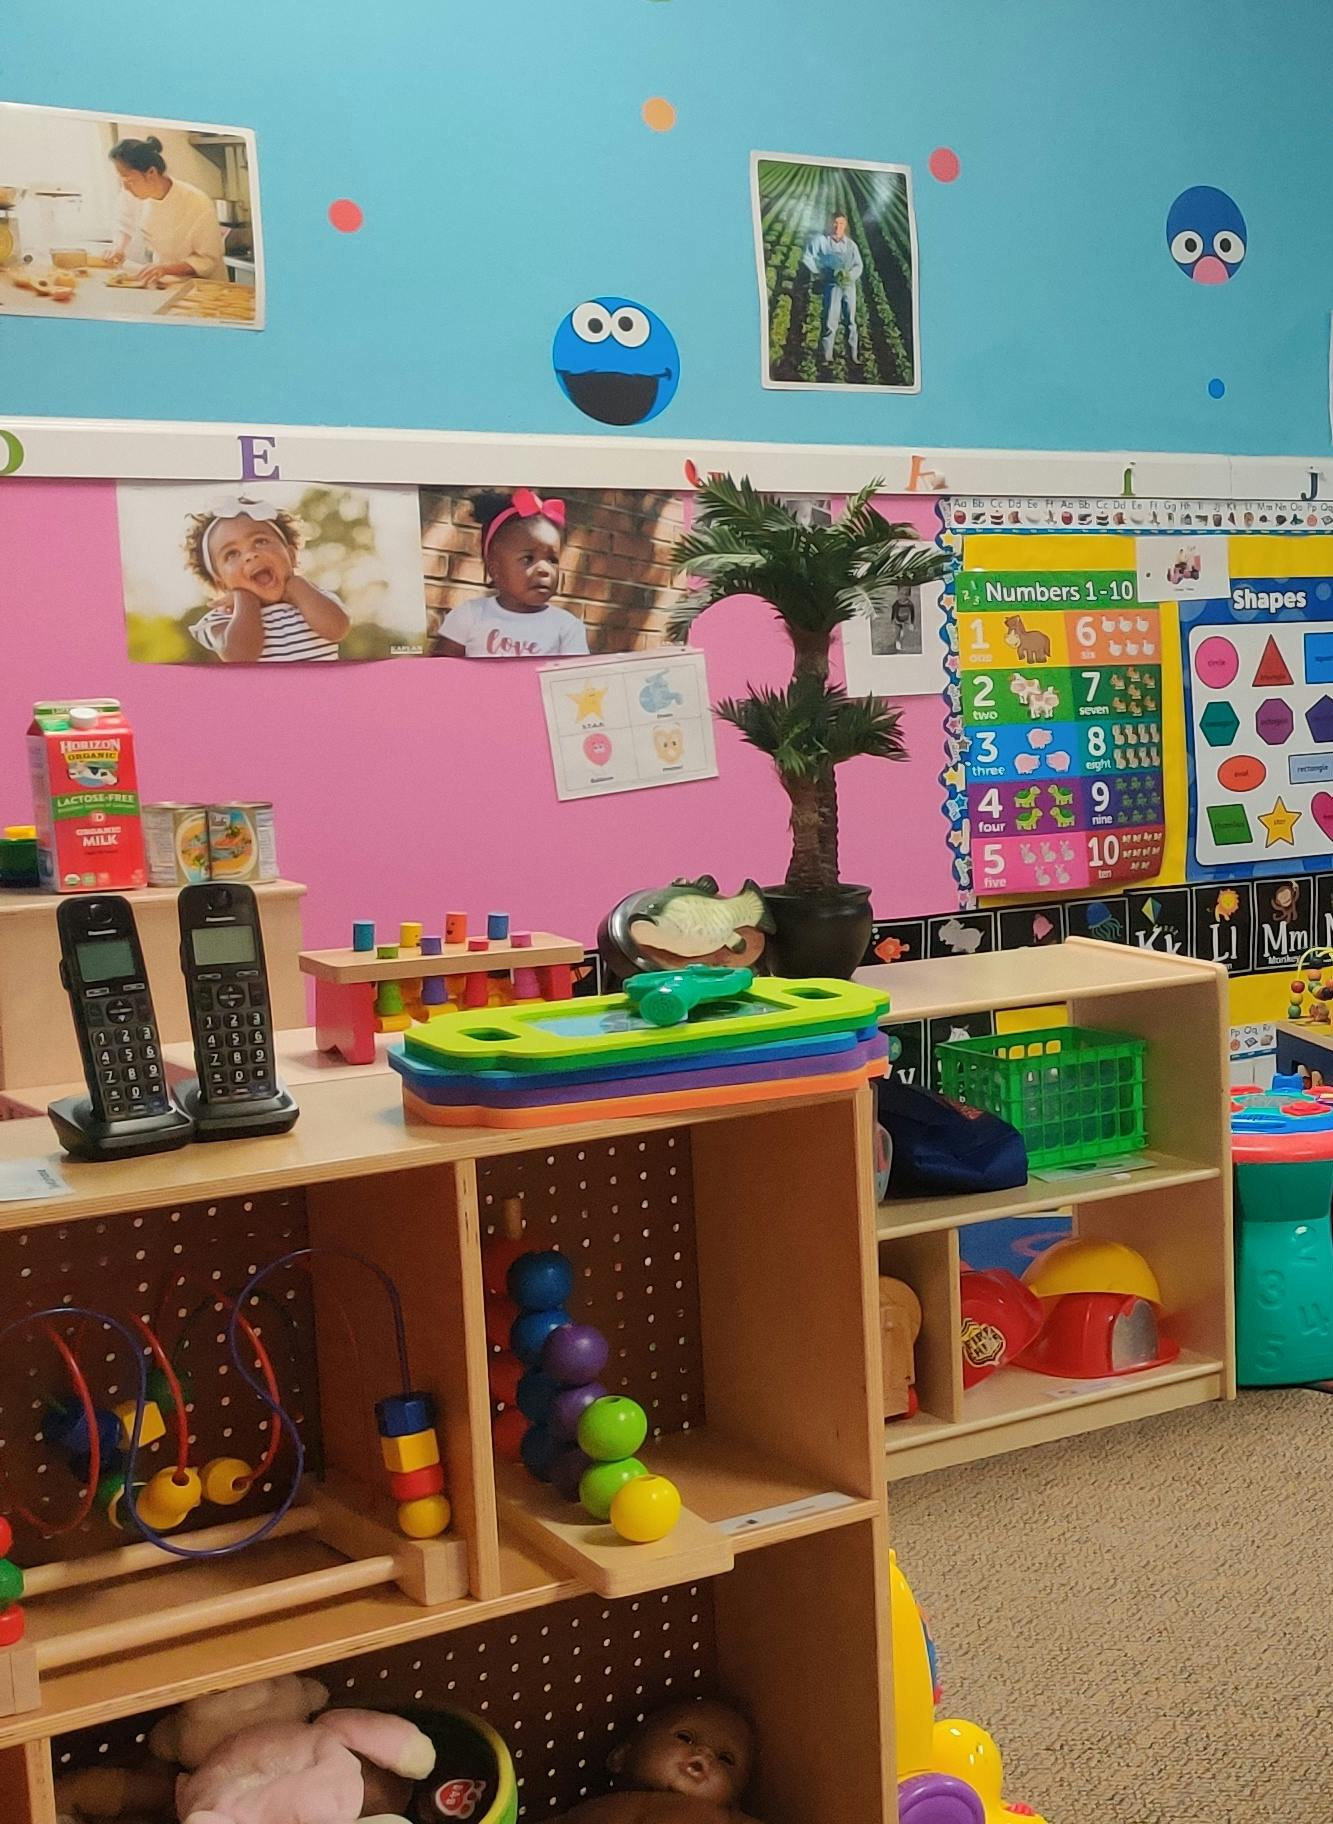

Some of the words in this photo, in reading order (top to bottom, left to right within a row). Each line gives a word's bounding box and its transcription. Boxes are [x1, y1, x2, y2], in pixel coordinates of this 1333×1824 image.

[237, 436, 280, 480] E
[1300, 468, 1321, 501] J
[985, 581, 1081, 602] Numbers
[1233, 589, 1307, 613] Shapes
[486, 628, 541, 655] love
[970, 618, 990, 649] 1
[1076, 616, 1097, 647] 6
[1081, 650, 1096, 660] six
[1208, 659, 1226, 667] circle
[973, 675, 995, 707] 2
[1081, 672, 1101, 702] 7
[972, 709, 998, 720] two
[1079, 706, 1110, 716] seven
[60, 738, 121, 754] HORIZON
[976, 732, 999, 763] 3
[1088, 726, 1107, 757] 8
[67, 751, 117, 762] ORGANIC
[1086, 759, 1112, 770] eight
[972, 766, 1006, 776] three
[1234, 769, 1248, 778] oval
[1297, 764, 1329, 773] rectangle
[57, 793, 135, 807] LACTOSE-FREE
[978, 788, 1003, 819] 4
[1091, 781, 1110, 812] 9
[978, 820, 1005, 833] four
[1092, 814, 1113, 825] nine
[82, 832, 118, 847] MILK
[984, 844, 1006, 875] 5
[1088, 835, 1120, 867] 10
[984, 876, 1006, 888] five
[1098, 869, 1112, 879] ten
[1135, 929, 1182, 954] Kk
[1209, 924, 1238, 963] Ll
[1262, 922, 1309, 957] Mm
